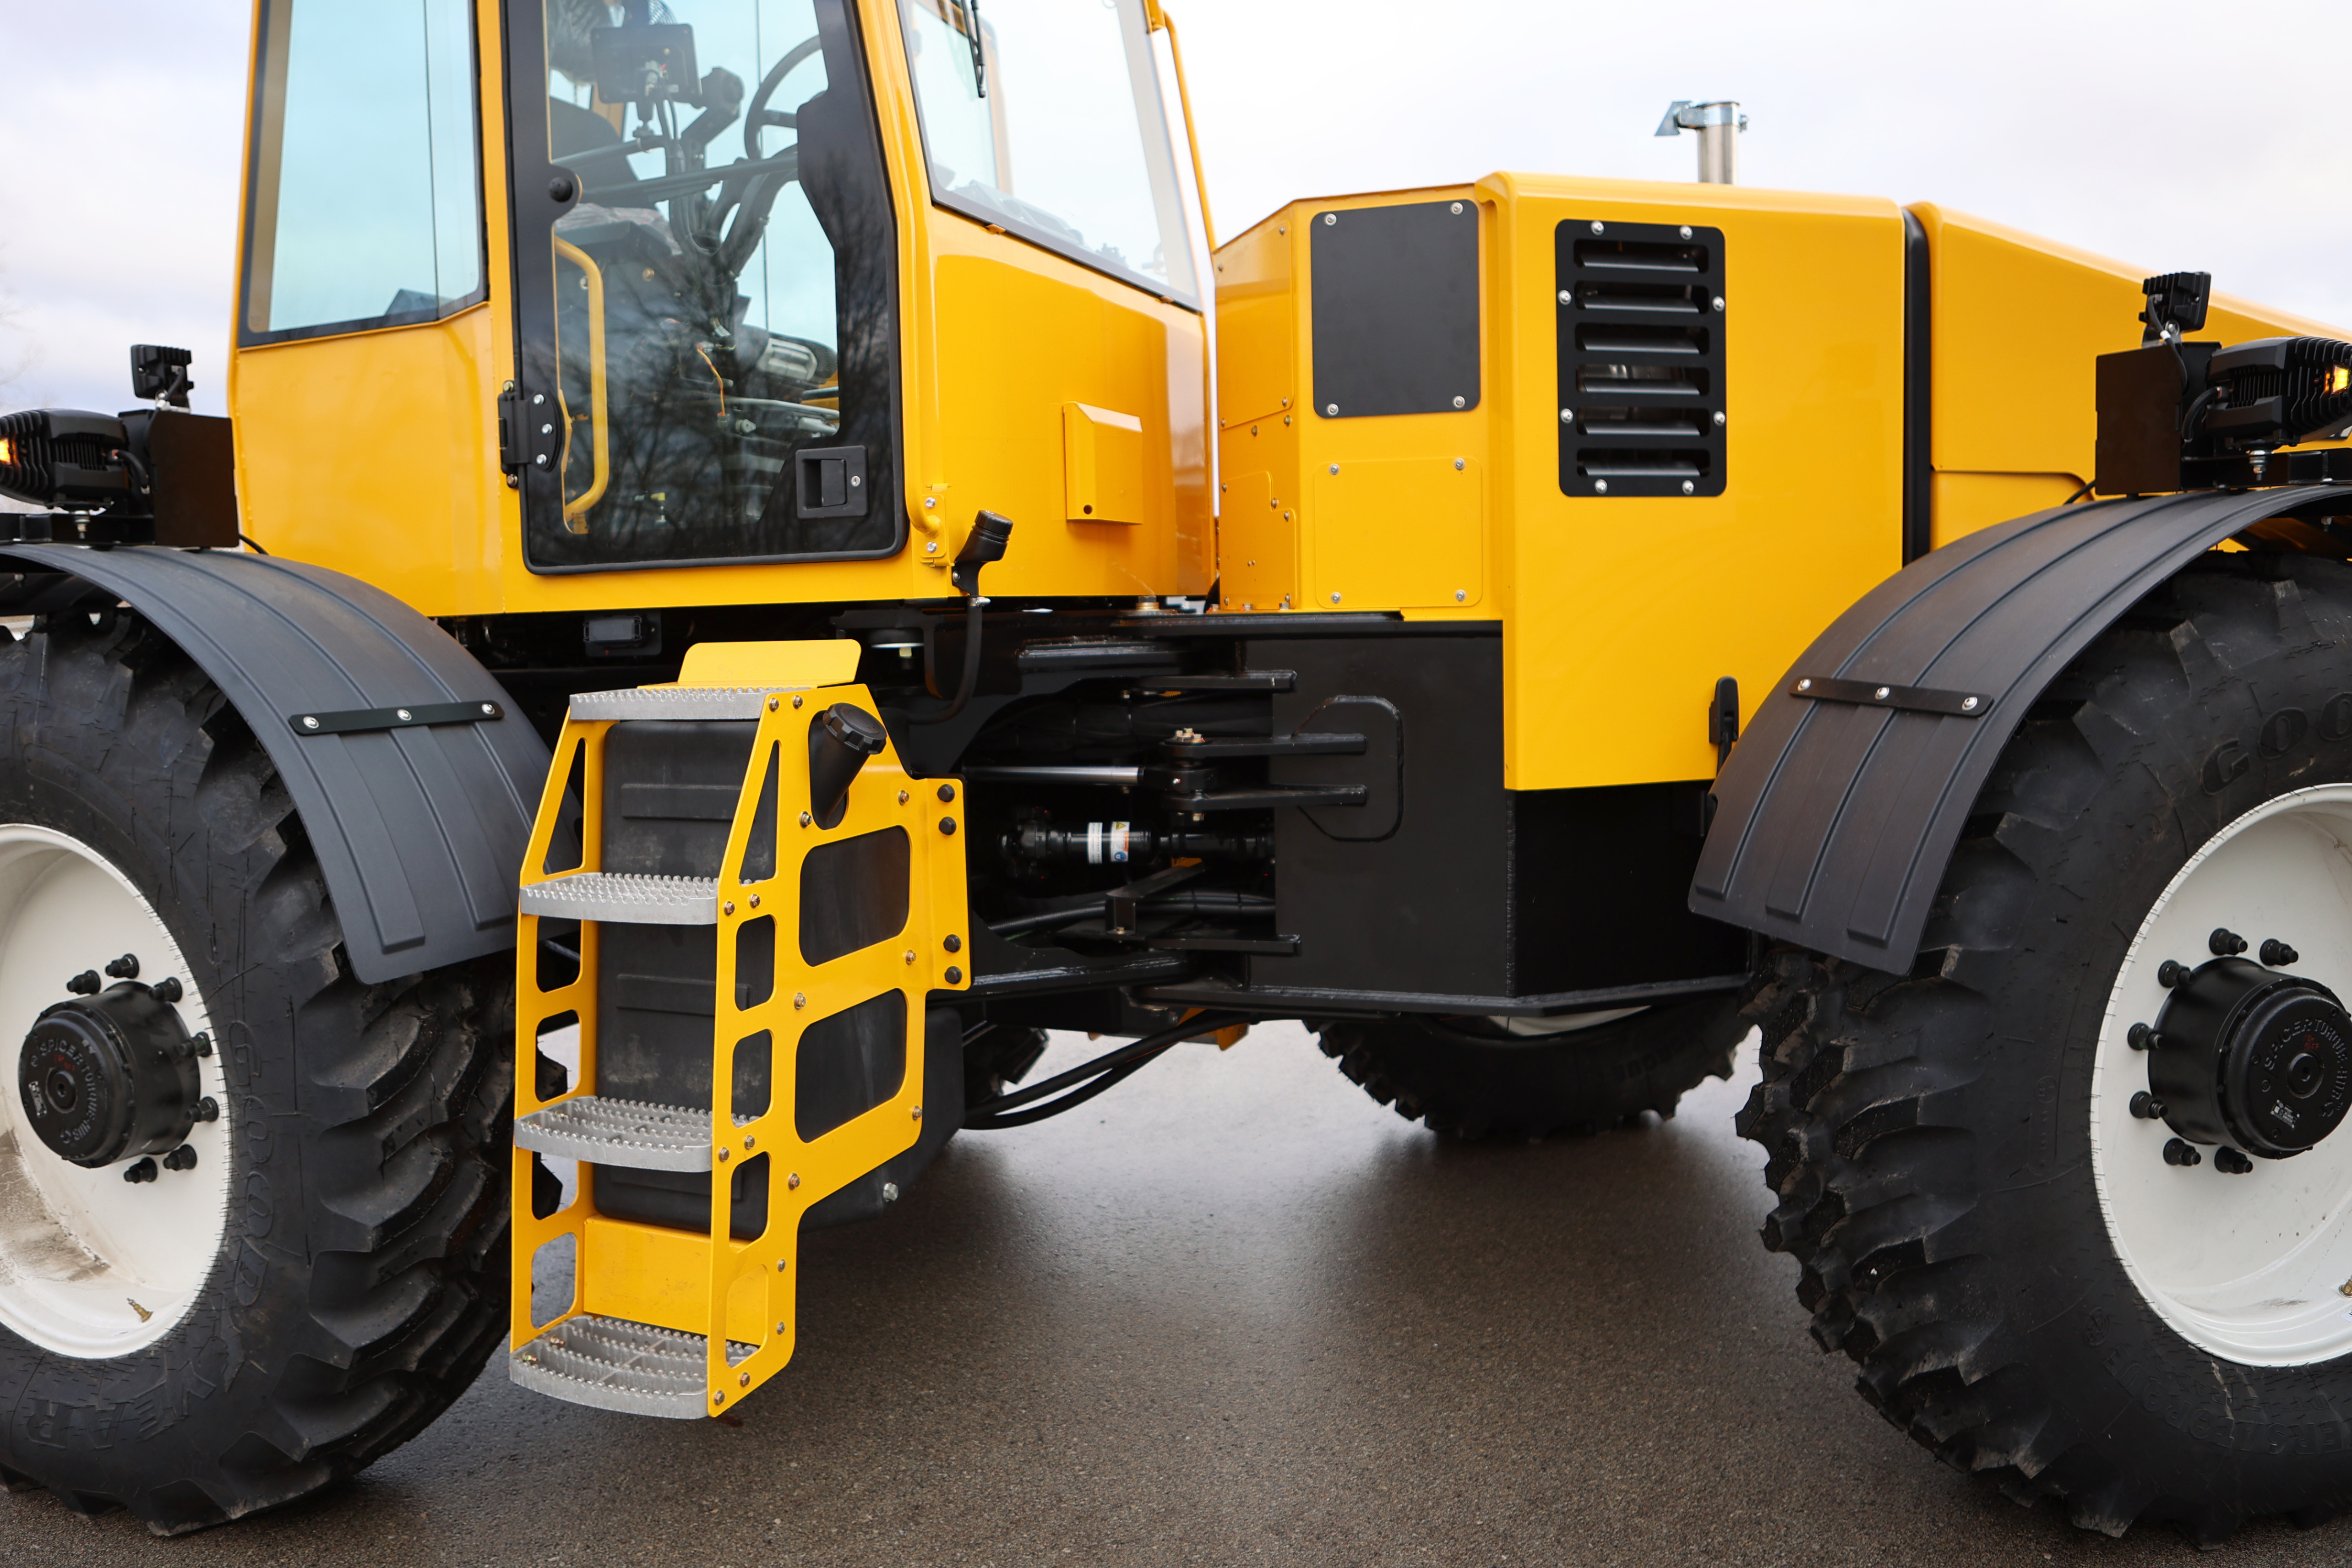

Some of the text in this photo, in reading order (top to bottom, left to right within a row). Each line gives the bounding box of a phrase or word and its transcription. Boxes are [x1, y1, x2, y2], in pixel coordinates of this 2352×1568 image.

[39, 1039, 84, 1066] SPICER
[2265, 1019, 2313, 1071] SPICER
[2103, 1344, 2352, 1455] ERSATORQUE
